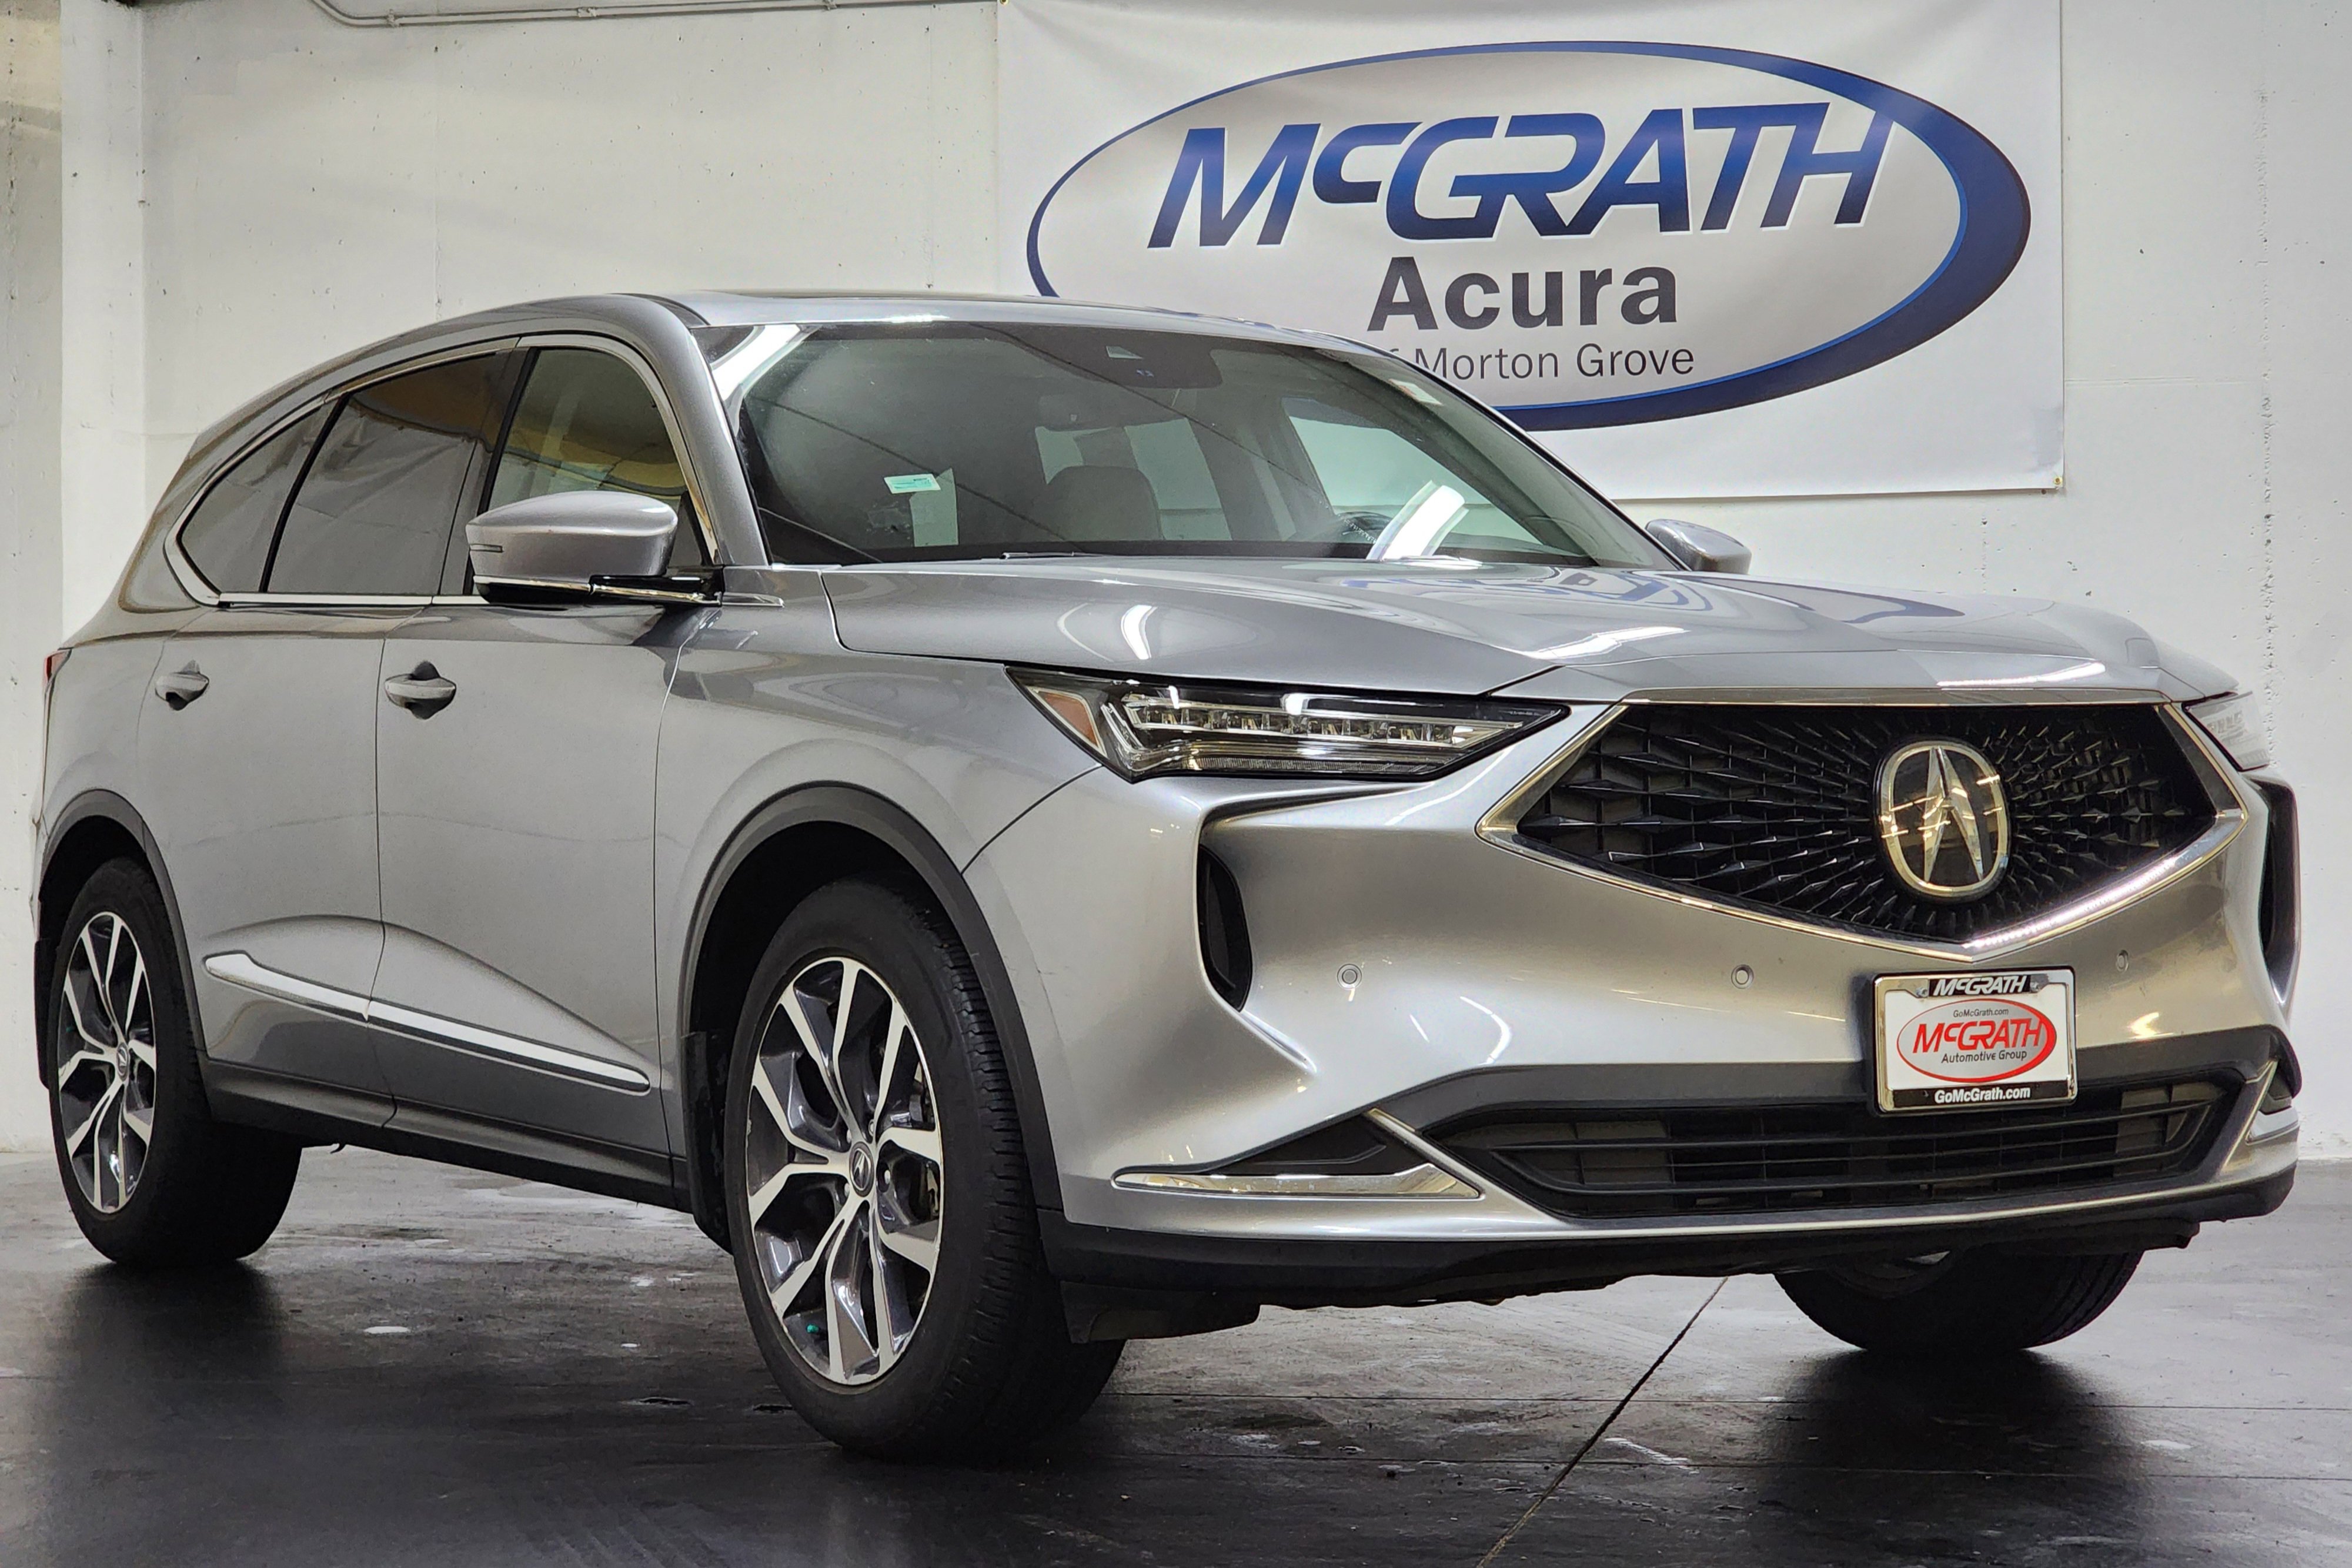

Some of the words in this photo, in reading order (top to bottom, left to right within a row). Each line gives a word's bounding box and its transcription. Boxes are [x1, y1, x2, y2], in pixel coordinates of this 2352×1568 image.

[1367, 256, 1677, 331] Acura
[1415, 347, 1559, 380] Morton
[1576, 343, 1694, 377] Grove
[1953, 1008, 2009, 1017] GoMcGrath.com
[1942, 1052, 1996, 1063] Automotive
[1999, 1049, 2027, 1061] Group
[1935, 1087, 2030, 1104] GoMcGrath.com
